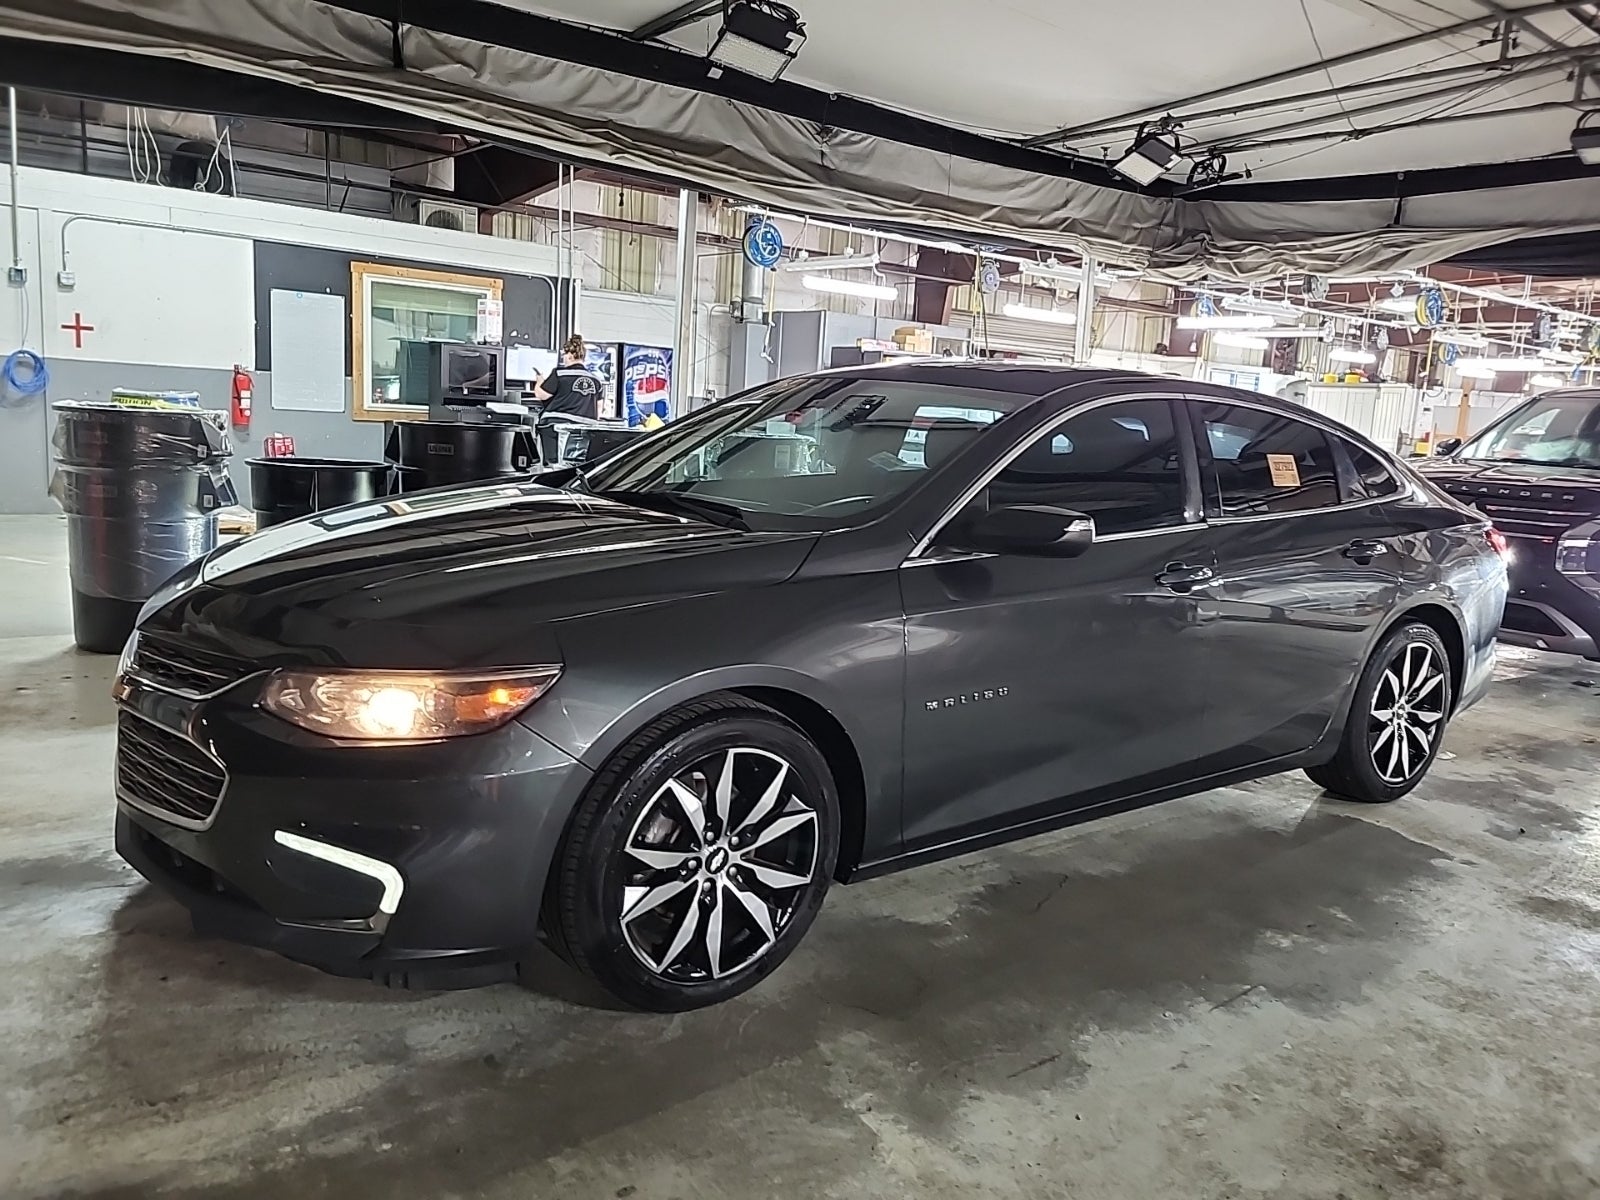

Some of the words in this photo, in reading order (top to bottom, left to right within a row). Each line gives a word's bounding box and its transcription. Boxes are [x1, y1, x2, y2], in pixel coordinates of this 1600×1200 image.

[625, 362, 667, 380] PEPS
[1443, 483, 1575, 500] TLANDER
[925, 686, 1009, 709] MALIBU
